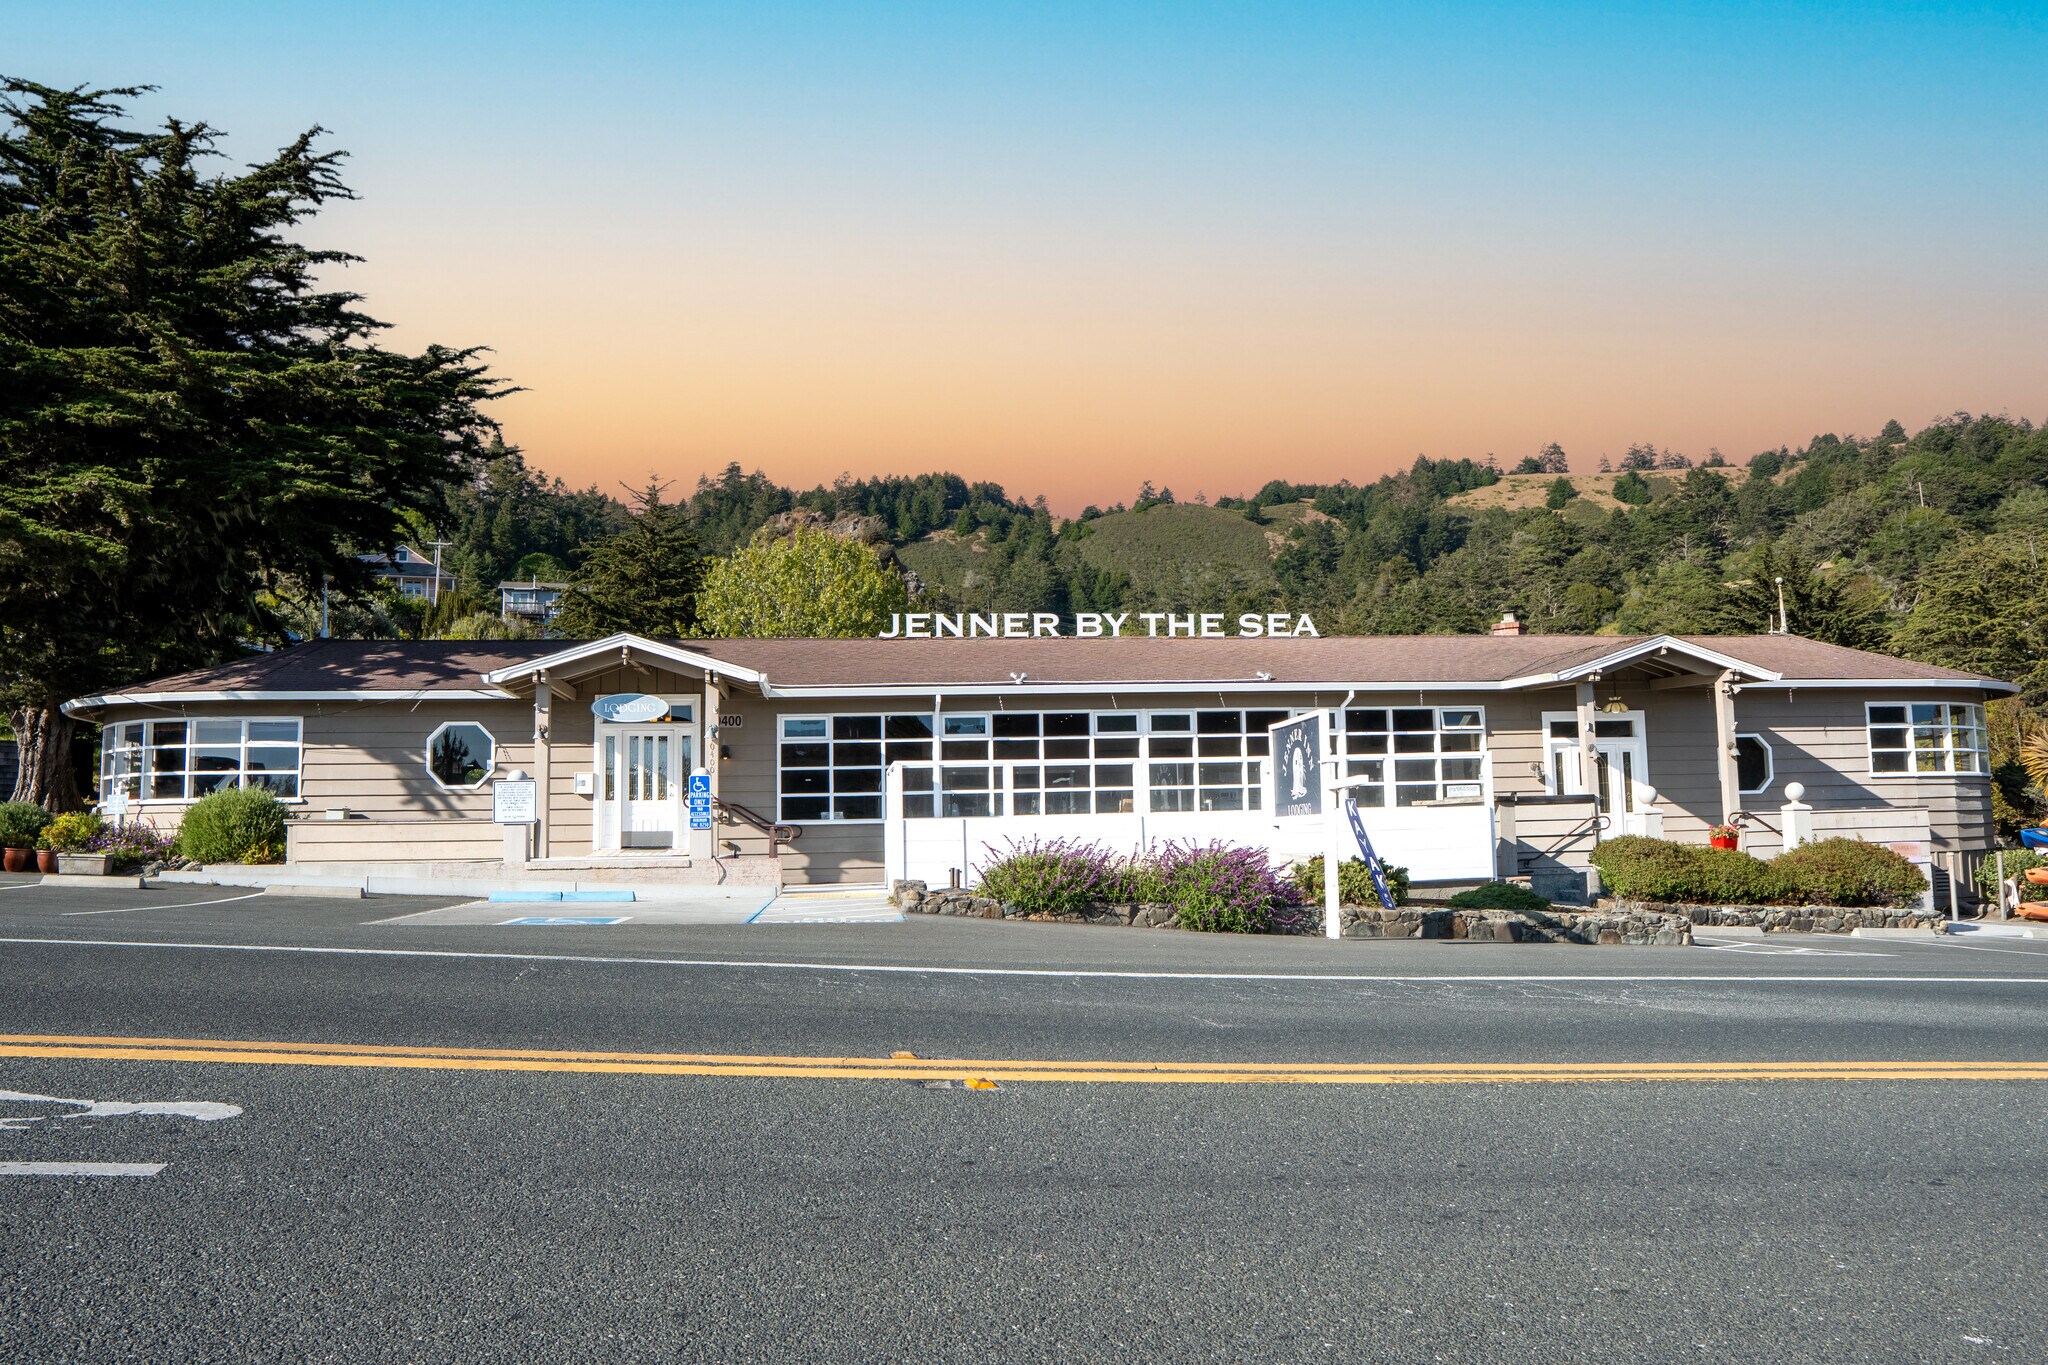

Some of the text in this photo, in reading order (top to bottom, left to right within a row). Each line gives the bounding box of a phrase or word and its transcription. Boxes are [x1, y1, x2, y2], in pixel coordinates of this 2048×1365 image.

[879, 613, 1321, 638] JENNER BY THE SEA
[604, 703, 656, 713] LODGING
[1282, 728, 1302, 777] JENNER
[1287, 802, 1312, 816] LODGING
[1347, 800, 1393, 908] KAYAKS
